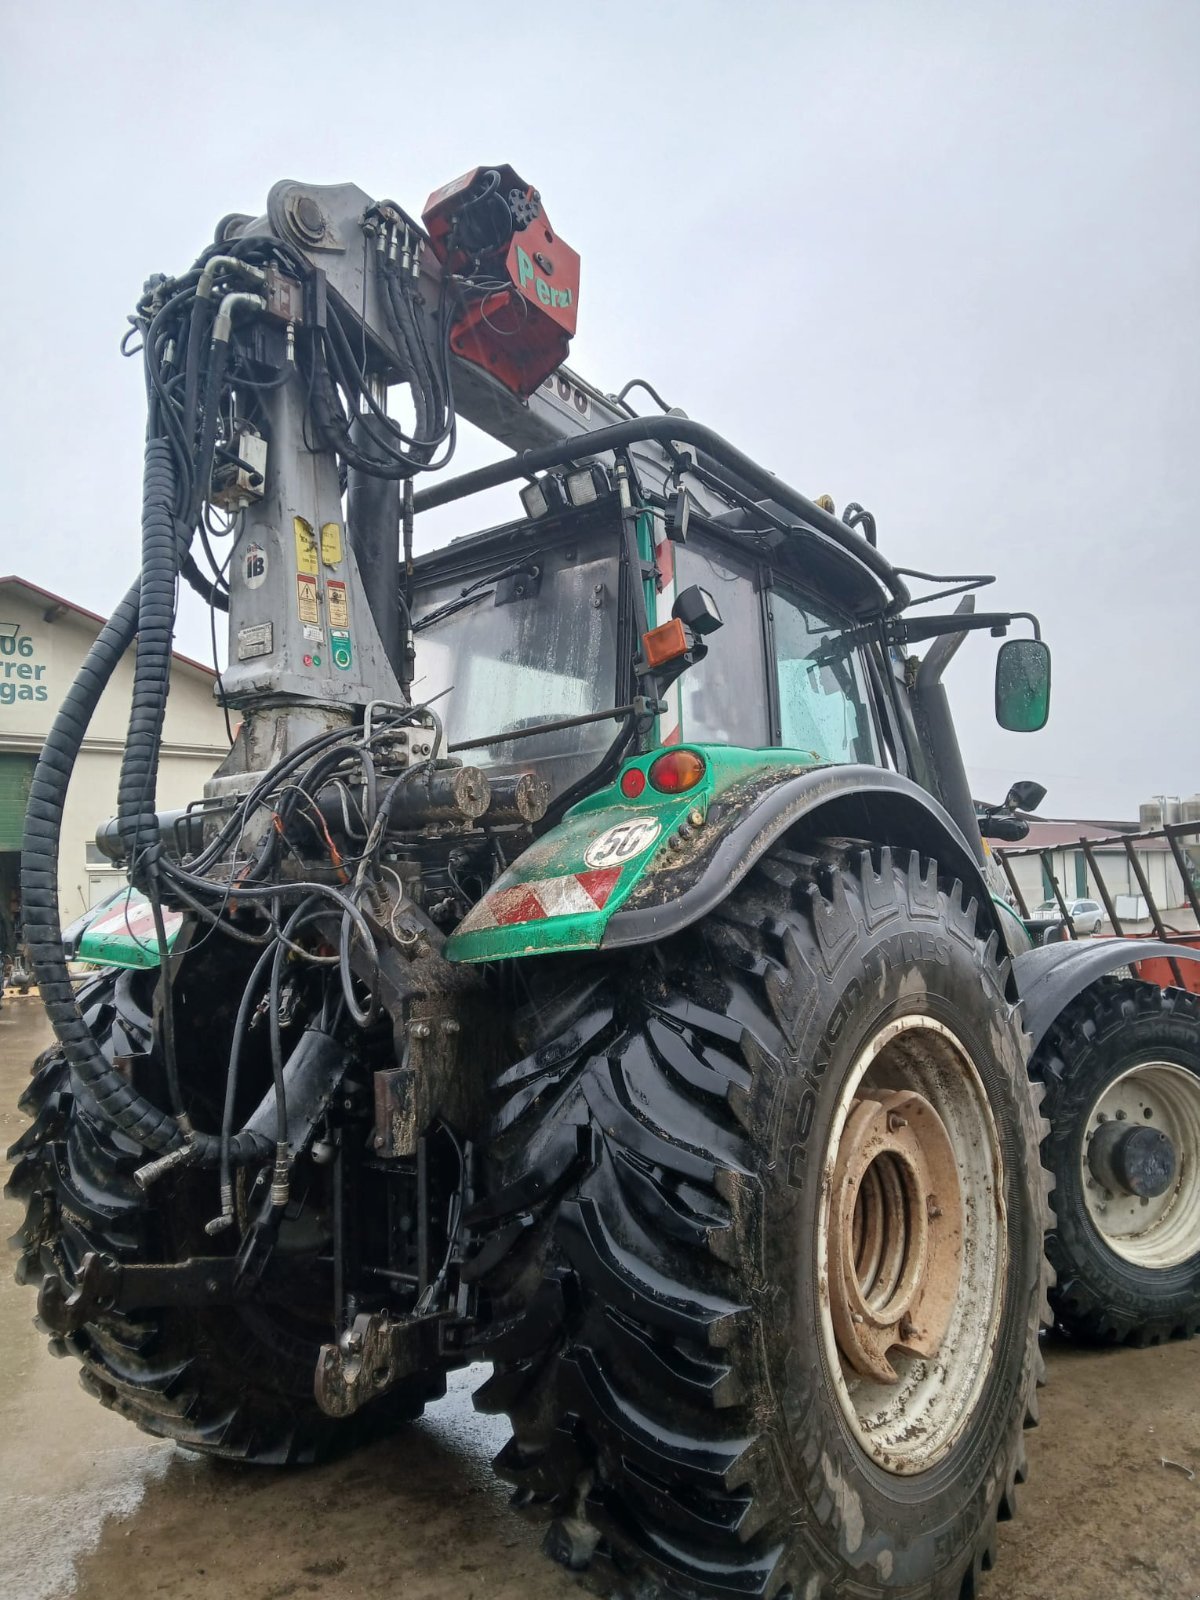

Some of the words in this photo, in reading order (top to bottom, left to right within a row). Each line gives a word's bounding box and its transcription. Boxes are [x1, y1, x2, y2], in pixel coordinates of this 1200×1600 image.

[0, 661, 46, 680] rer
[0, 682, 48, 704] gas
[594, 824, 648, 861] 50
